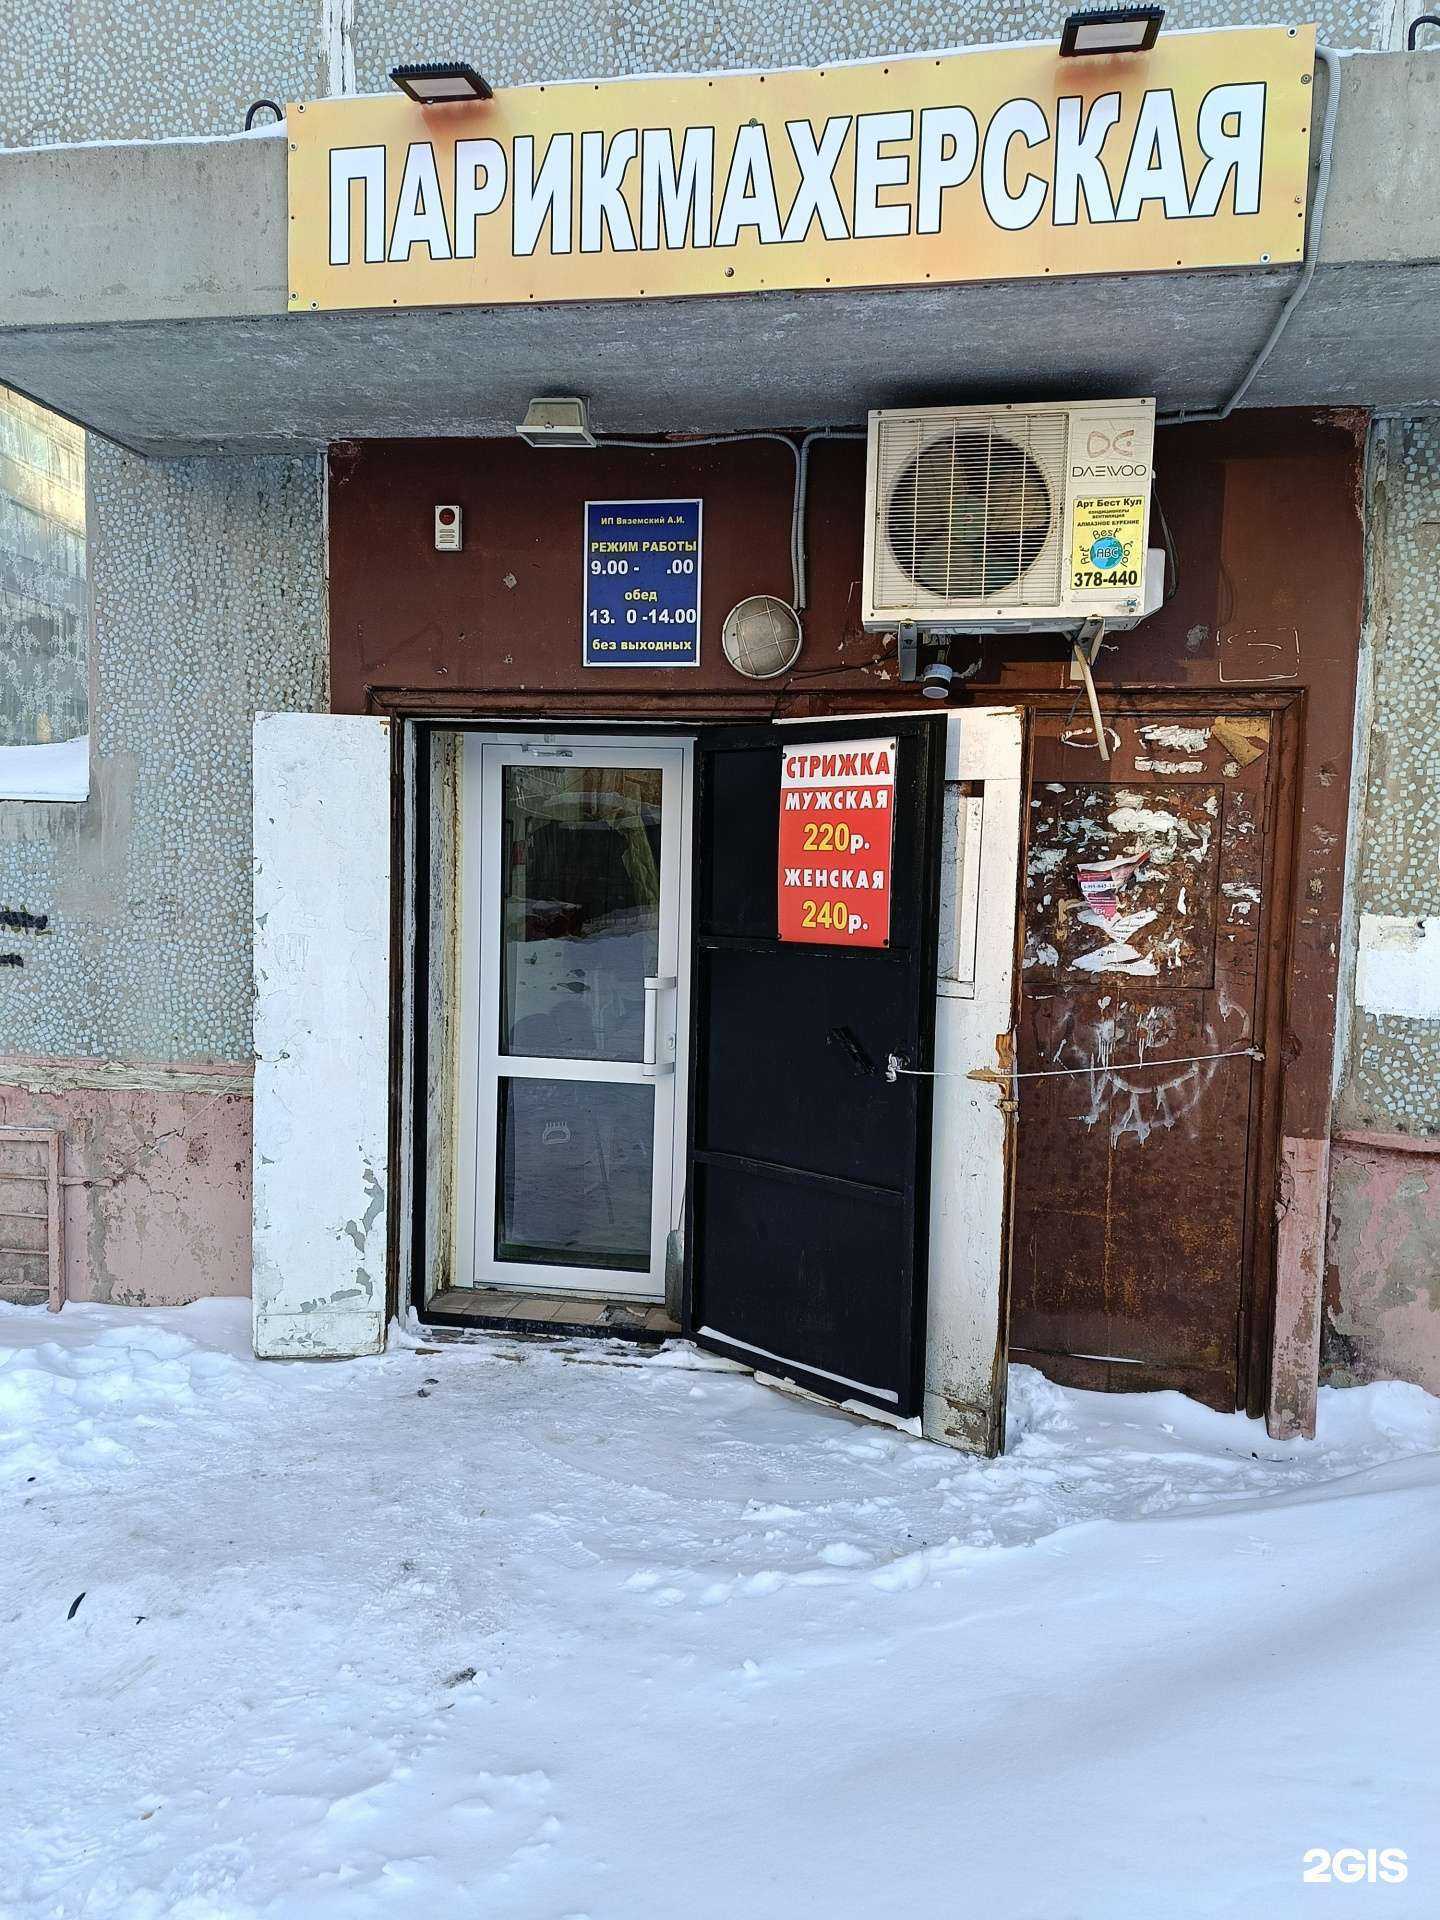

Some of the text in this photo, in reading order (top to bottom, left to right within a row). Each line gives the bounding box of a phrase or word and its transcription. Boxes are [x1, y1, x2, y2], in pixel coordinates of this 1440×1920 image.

[327, 81, 1268, 267] ПАРИКМАХЕРСКАЯ
[1072, 464, 1147, 478] DAEWOO
[1076, 498, 1142, 509] Арт Бест Кул
[601, 516, 685, 525] ИП Вяземский А.И.
[1092, 527, 1120, 540] Best
[591, 540, 697, 553] РЕЖИМ РАБОТЫ
[1096, 547, 1118, 559] ABC
[1073, 570, 1138, 588] 378-440
[624, 589, 658, 602] обед
[592, 639, 692, 651] без выходных
[785, 751, 891, 779] СТРИЖКА
[784, 789, 889, 811] МУЖСКАЯ
[784, 867, 885, 890] ЖЕНСКАЯ
